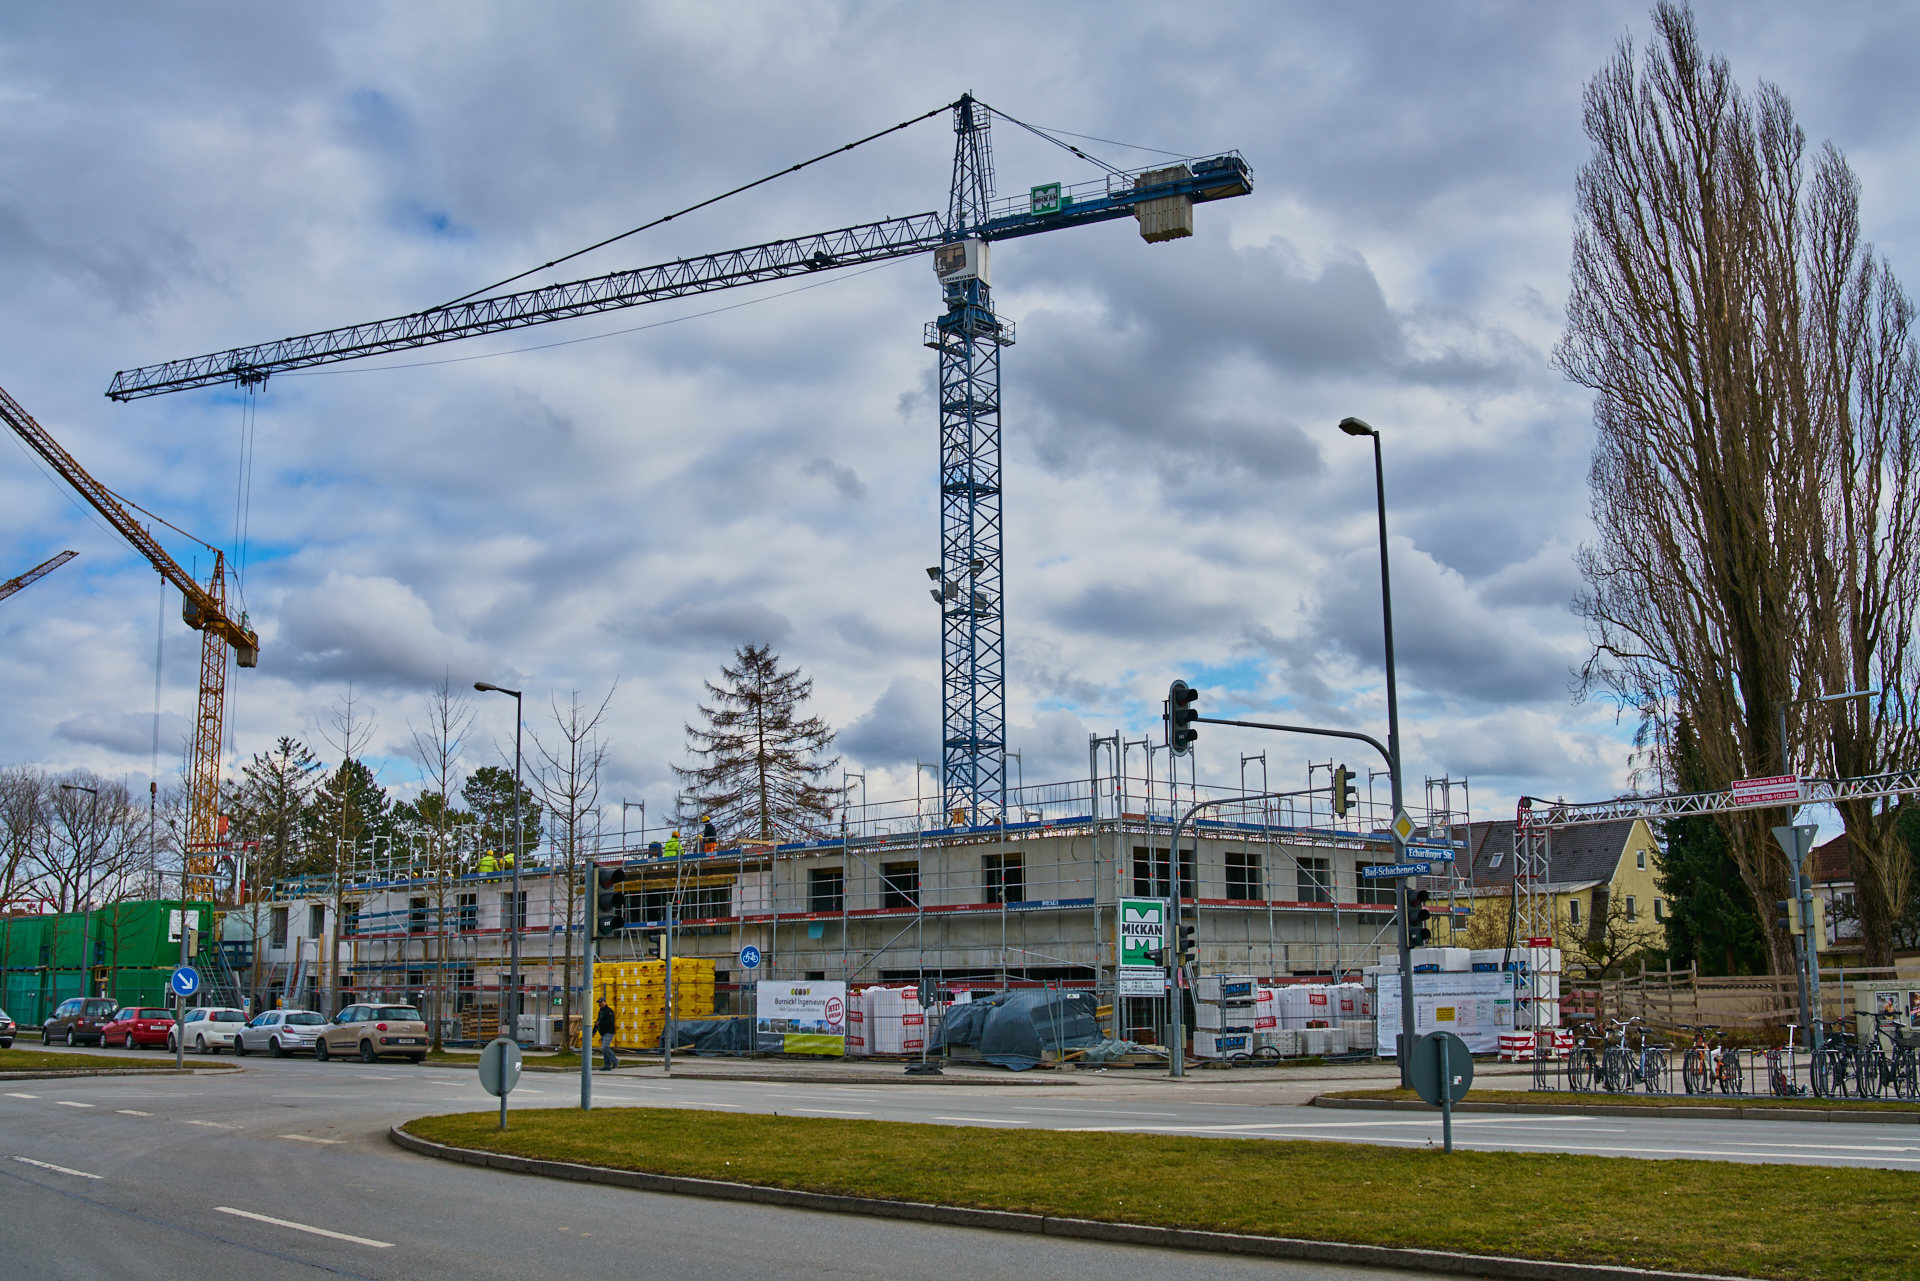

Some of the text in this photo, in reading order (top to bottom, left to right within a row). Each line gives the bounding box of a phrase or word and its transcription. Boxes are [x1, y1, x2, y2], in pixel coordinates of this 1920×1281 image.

[1408, 848, 1453, 860] Echardinger Str.
[1364, 864, 1428, 877] Bad-Schachener-Str.
[1121, 923, 1163, 935] MICKAN
[774, 997, 826, 1007] Burnickl Ingenieure
[828, 1003, 840, 1013] JETZT
